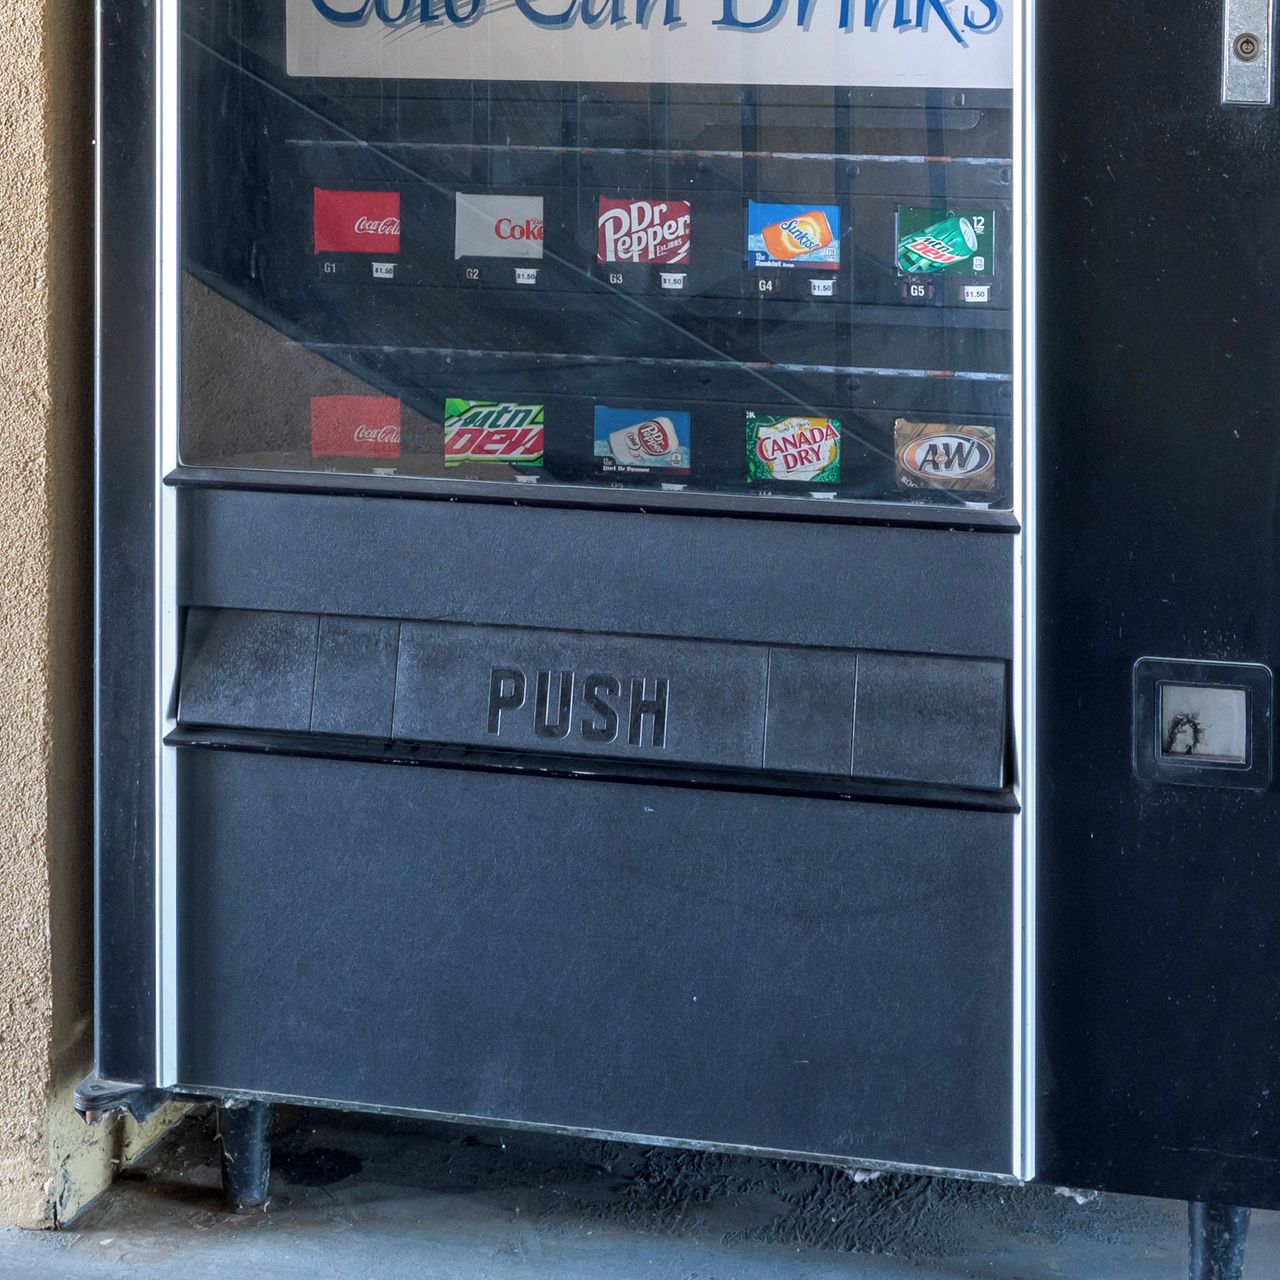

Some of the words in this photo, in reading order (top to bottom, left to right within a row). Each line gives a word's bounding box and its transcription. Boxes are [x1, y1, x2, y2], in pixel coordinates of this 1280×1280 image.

[629, 201, 668, 233] Dr
[972, 216, 985, 229] 12
[598, 208, 691, 263] Pepper
[780, 219, 821, 250] Sunkist
[324, 262, 336, 273] G1
[375, 267, 393, 275] $1.50
[466, 268, 479, 280] G2
[610, 273, 623, 285] G3
[663, 277, 682, 285] $1.50
[758, 280, 773, 292] G4
[812, 284, 832, 292] $1.50
[910, 285, 925, 297] G5
[965, 290, 985, 299] $1.50
[757, 423, 839, 462] CANADA
[783, 445, 822, 471] DRY
[487, 665, 670, 749] PUSH
